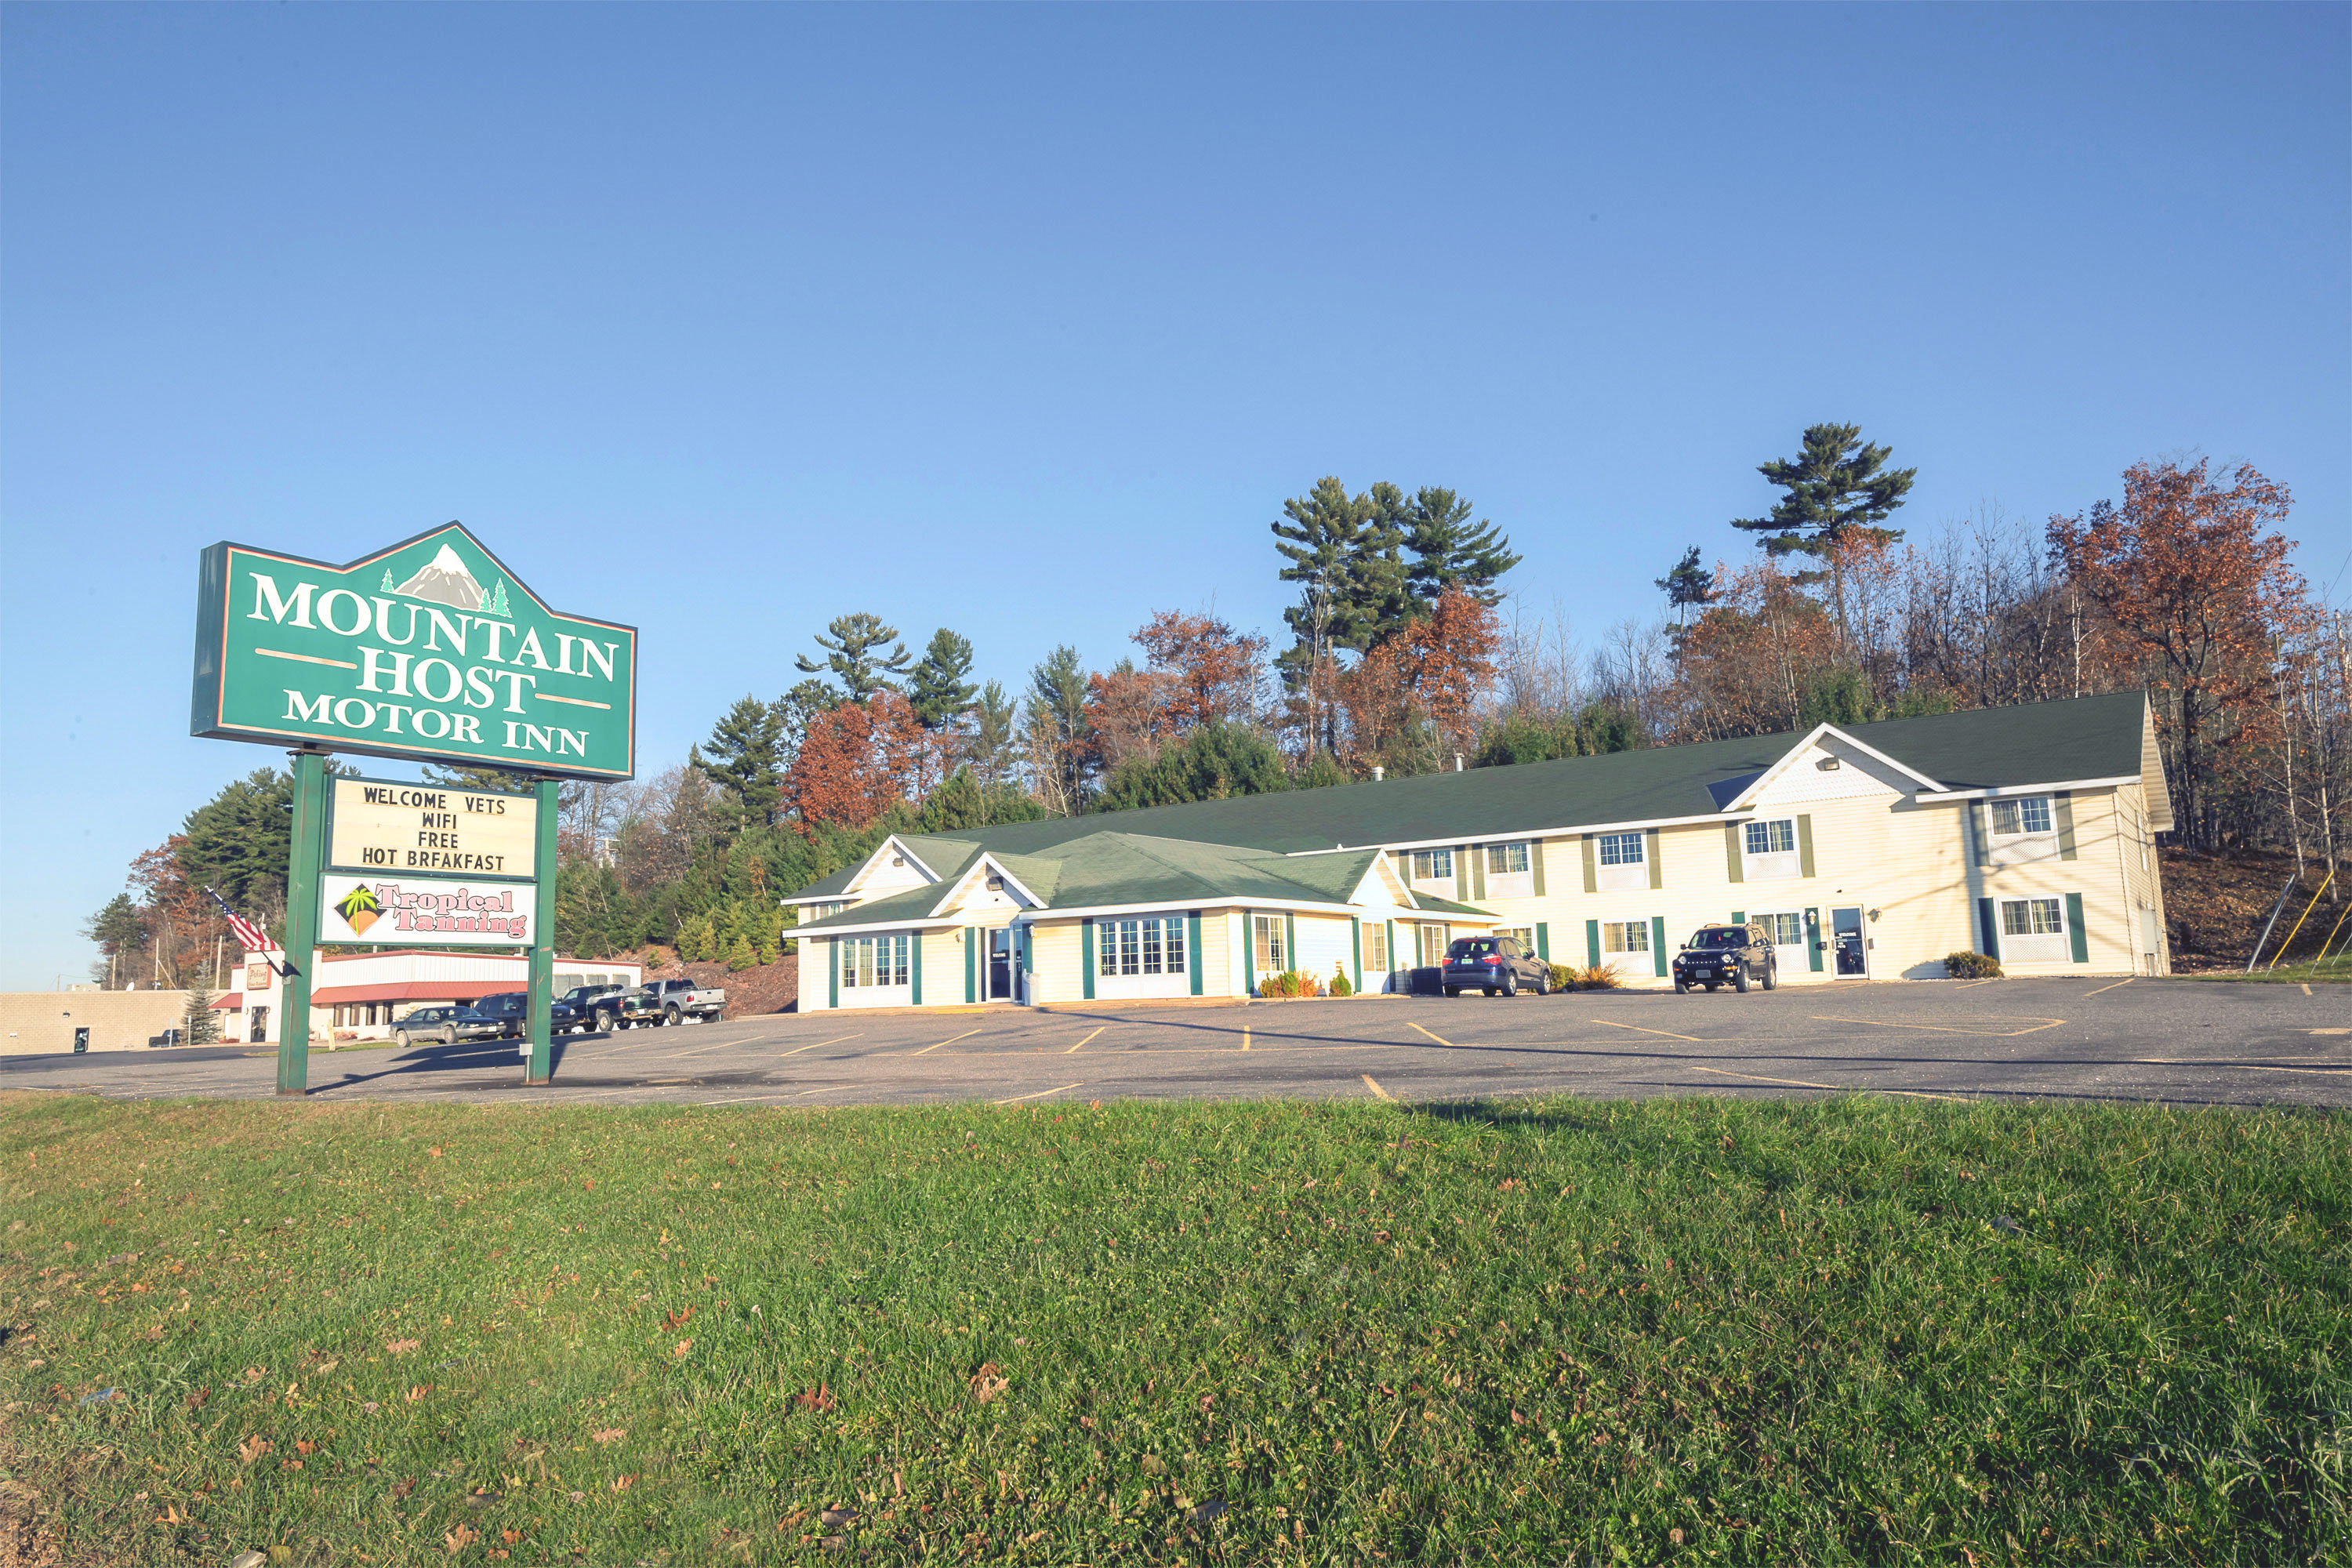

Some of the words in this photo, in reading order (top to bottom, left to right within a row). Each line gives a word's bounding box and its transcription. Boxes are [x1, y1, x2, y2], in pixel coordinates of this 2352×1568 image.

[246, 572, 620, 682] MOUNTAIN
[356, 645, 537, 714] HOST
[281, 688, 485, 744] MOTOR
[502, 720, 590, 757] INN
[364, 787, 446, 809] WELCOME
[466, 797, 505, 815] VETS
[422, 812, 457, 829] WIFI
[418, 831, 459, 849] FREE
[362, 848, 397, 865] HOT
[376, 884, 513, 916] Tropical
[394, 907, 527, 938] Tanning
